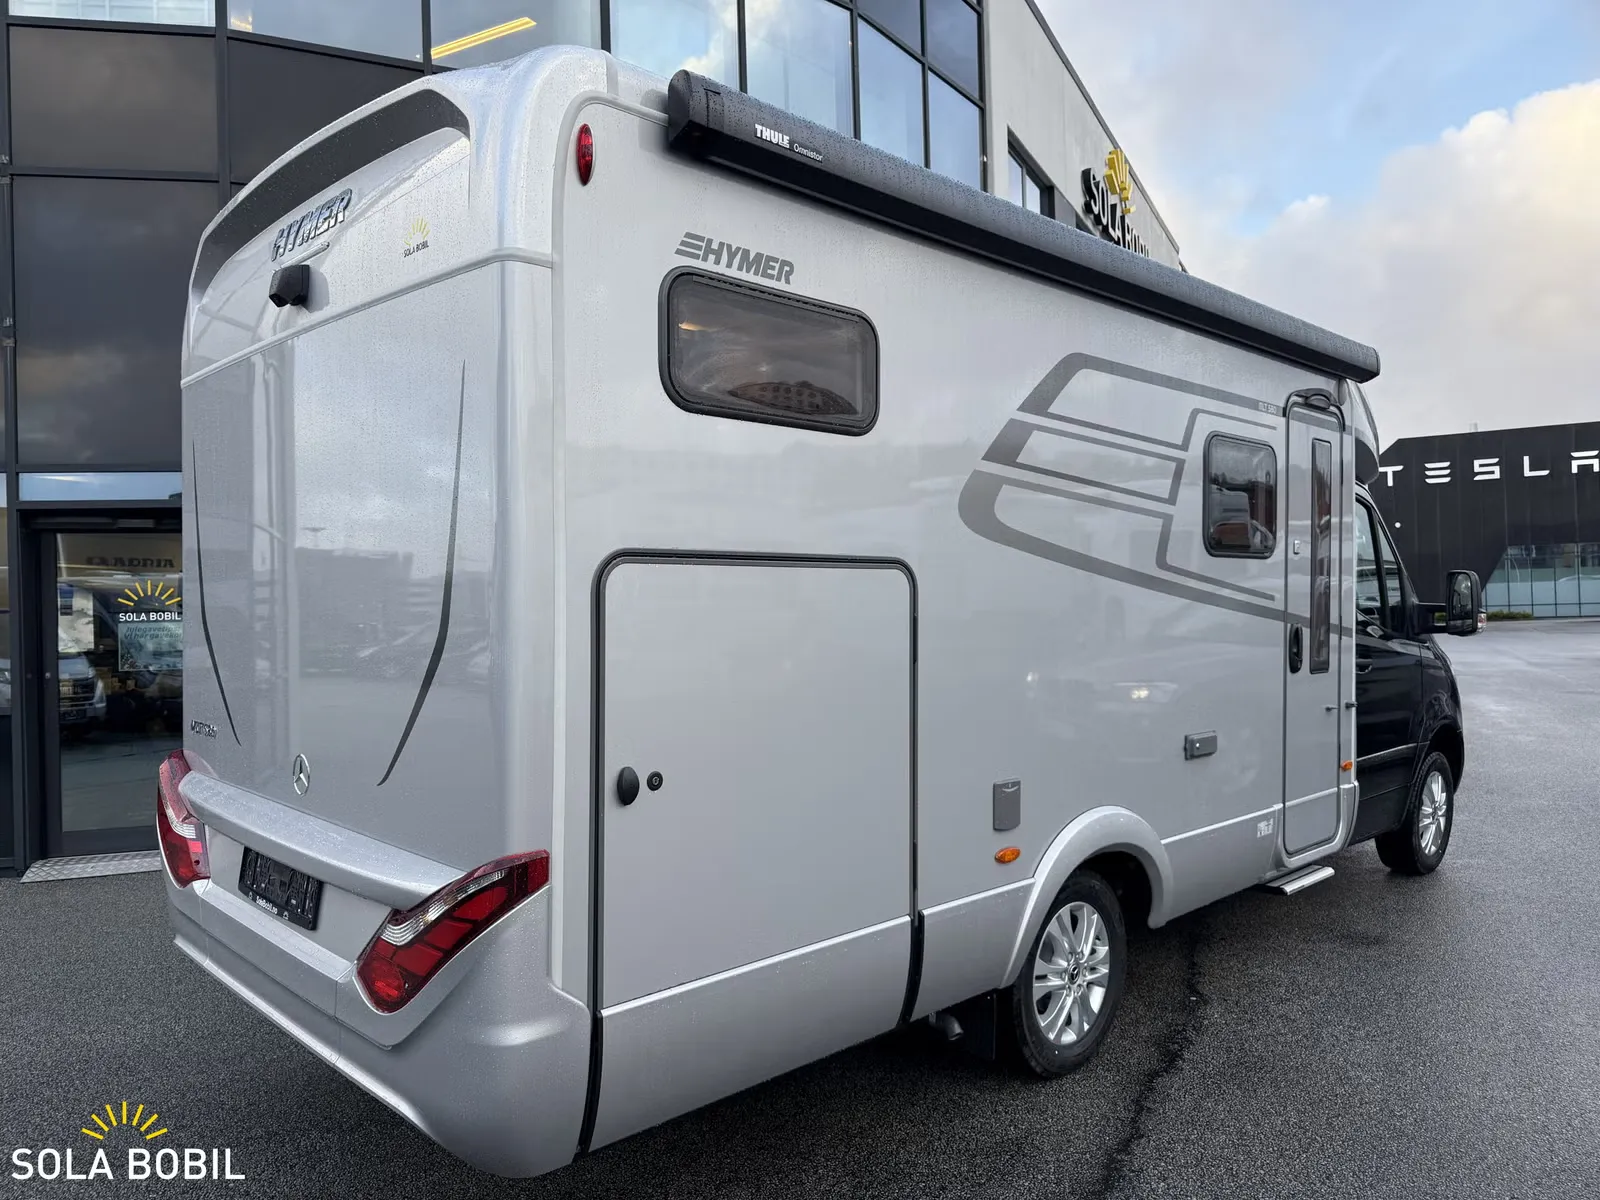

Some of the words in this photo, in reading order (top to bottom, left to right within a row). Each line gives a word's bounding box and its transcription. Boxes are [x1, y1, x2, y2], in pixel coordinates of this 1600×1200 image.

[755, 123, 790, 149] THULE
[793, 143, 823, 162] Omnistor
[272, 188, 352, 262] HYMER
[1081, 167, 1126, 250] SOLA
[403, 246, 415, 258] SOLA
[415, 240, 430, 253] BOBIL
[700, 237, 795, 285] HYMER
[1379, 450, 1600, 487] TESLA
[119, 612, 147, 622] SOLA
[150, 611, 182, 621] BOBIL
